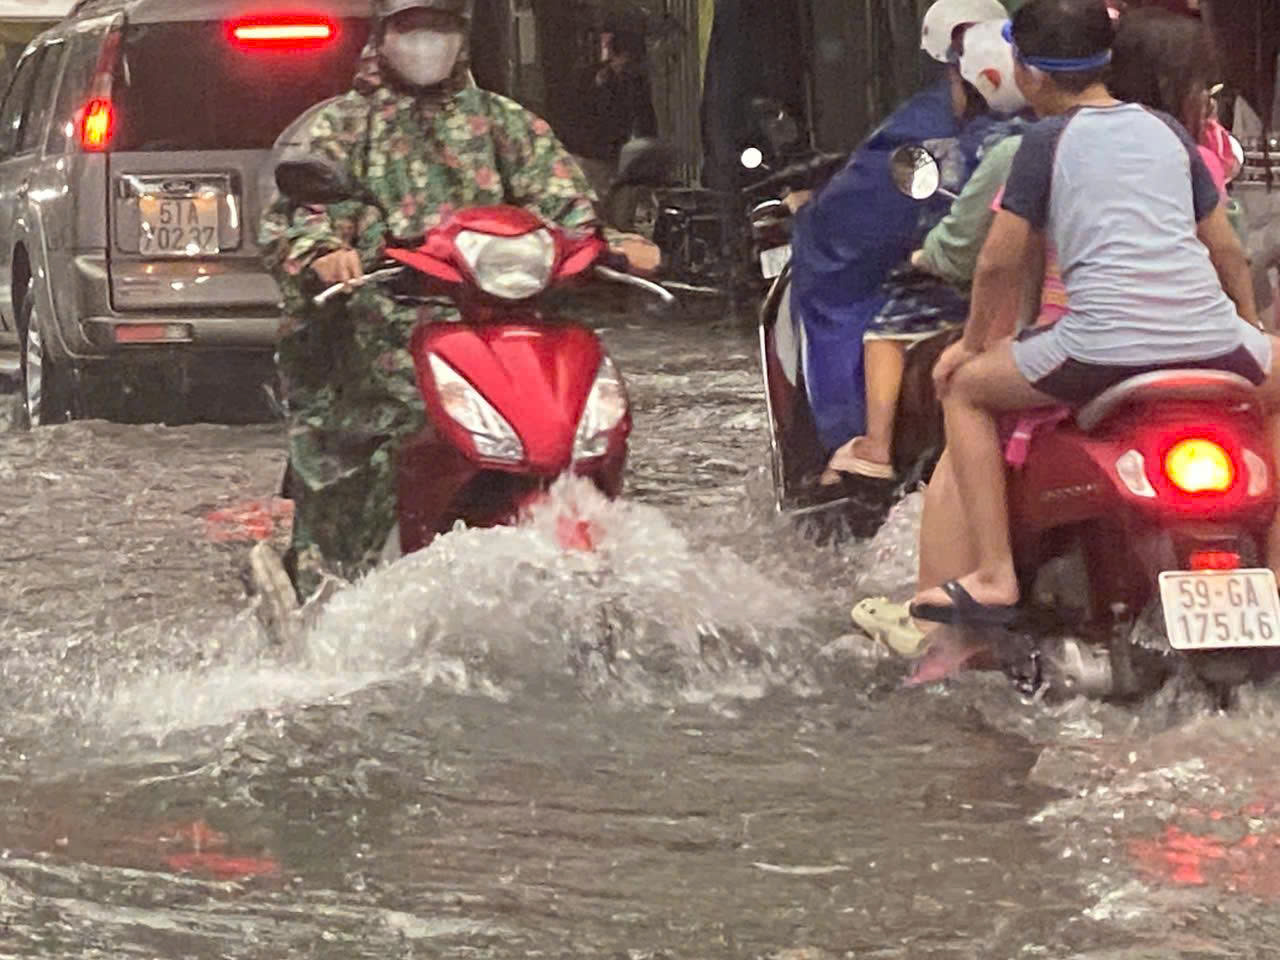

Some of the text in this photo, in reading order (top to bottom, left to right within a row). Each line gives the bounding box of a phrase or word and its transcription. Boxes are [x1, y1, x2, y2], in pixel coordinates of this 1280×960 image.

[159, 201, 200, 225] 51A
[1177, 576, 1260, 609] 59-GA
[1177, 611, 1274, 644] 175.46
